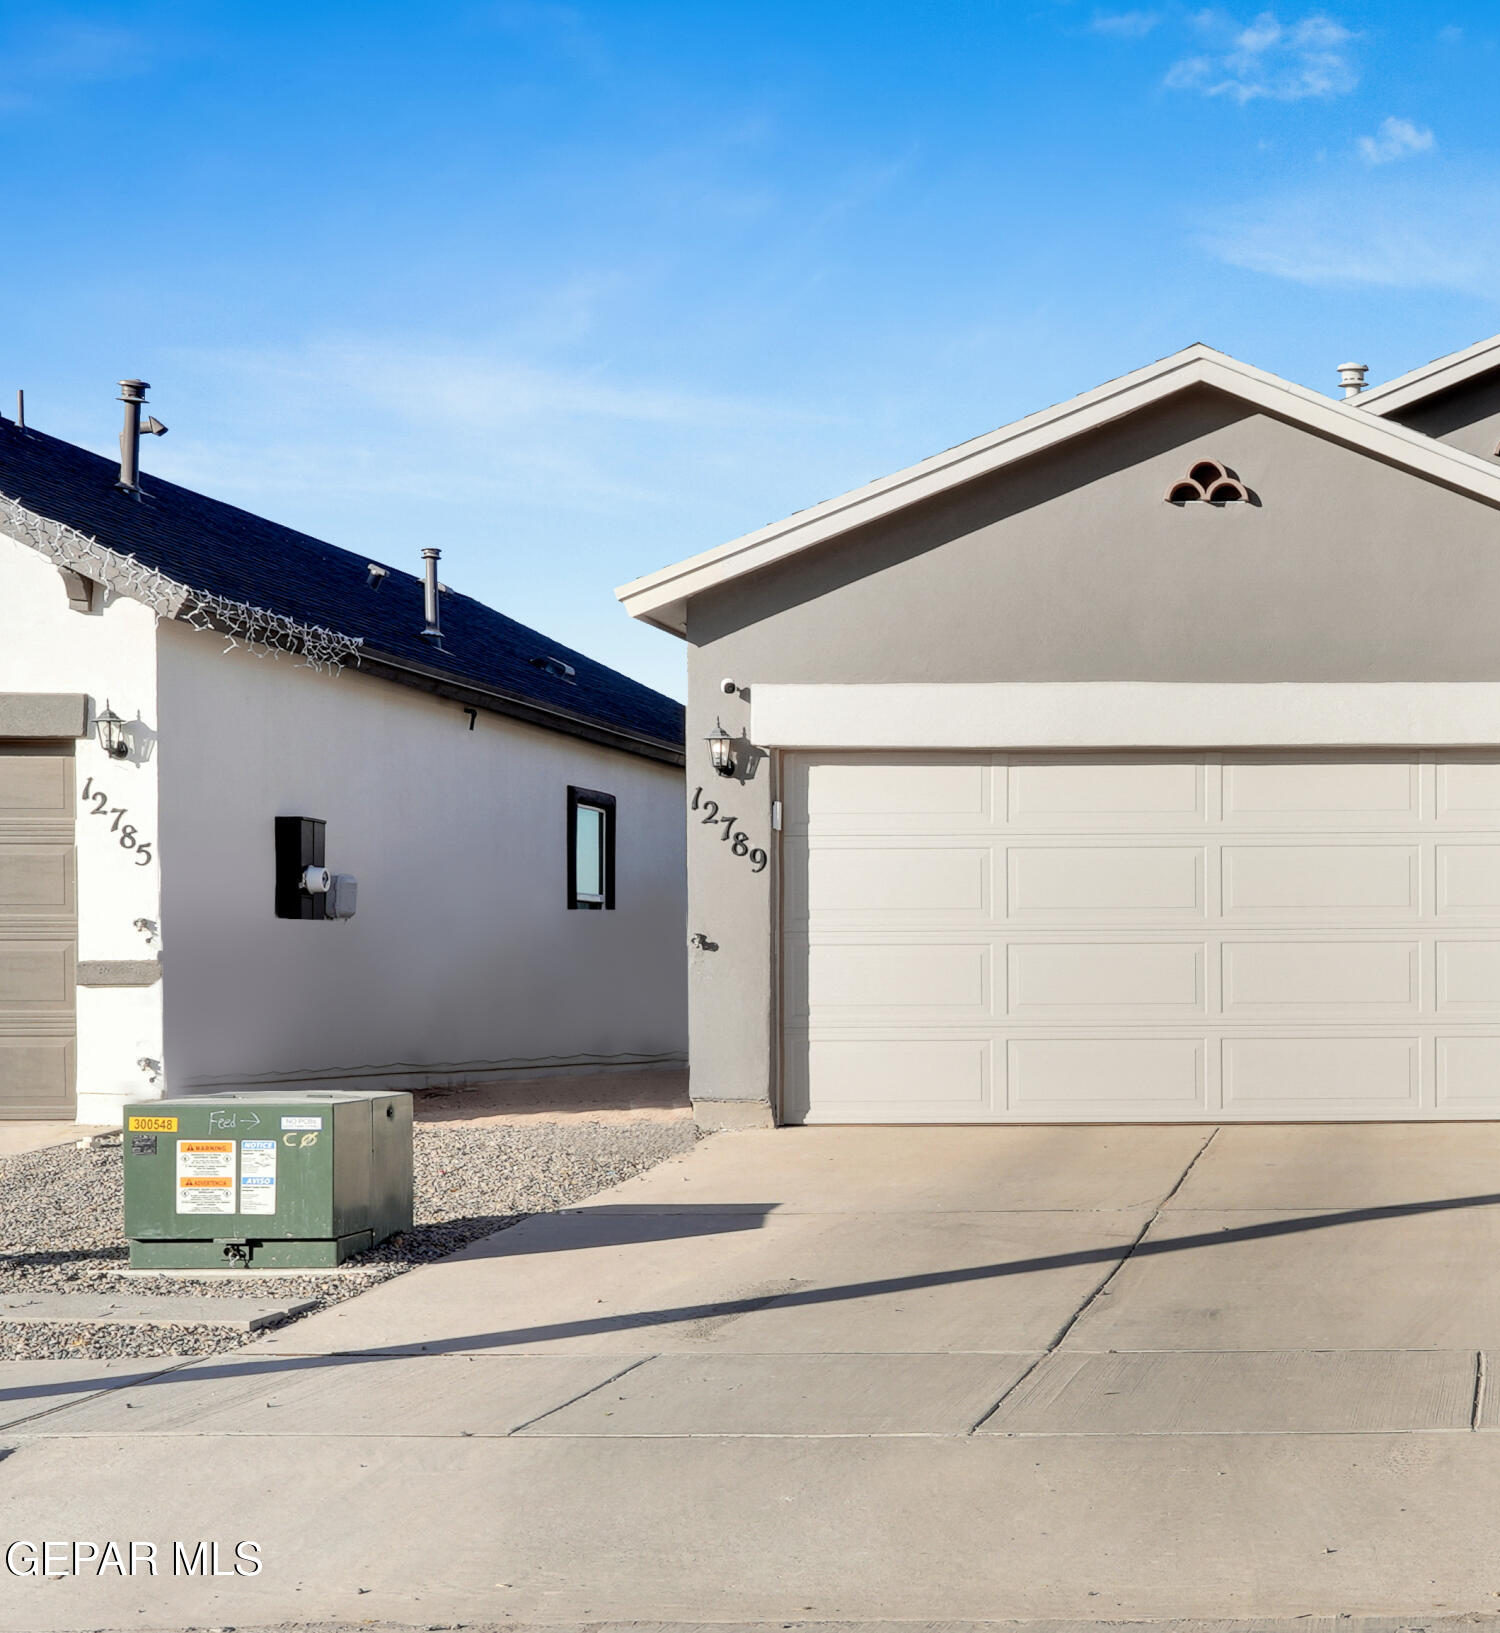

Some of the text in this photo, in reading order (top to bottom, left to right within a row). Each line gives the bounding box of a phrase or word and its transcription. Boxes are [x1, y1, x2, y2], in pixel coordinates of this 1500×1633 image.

[82, 777, 152, 866] 12785
[691, 786, 768, 873] 12789
[134, 1119, 173, 1130] 300548
[208, 1110, 237, 1135] Feed
[243, 1141, 273, 1149] NOTICE
[246, 1177, 271, 1185] AVISO
